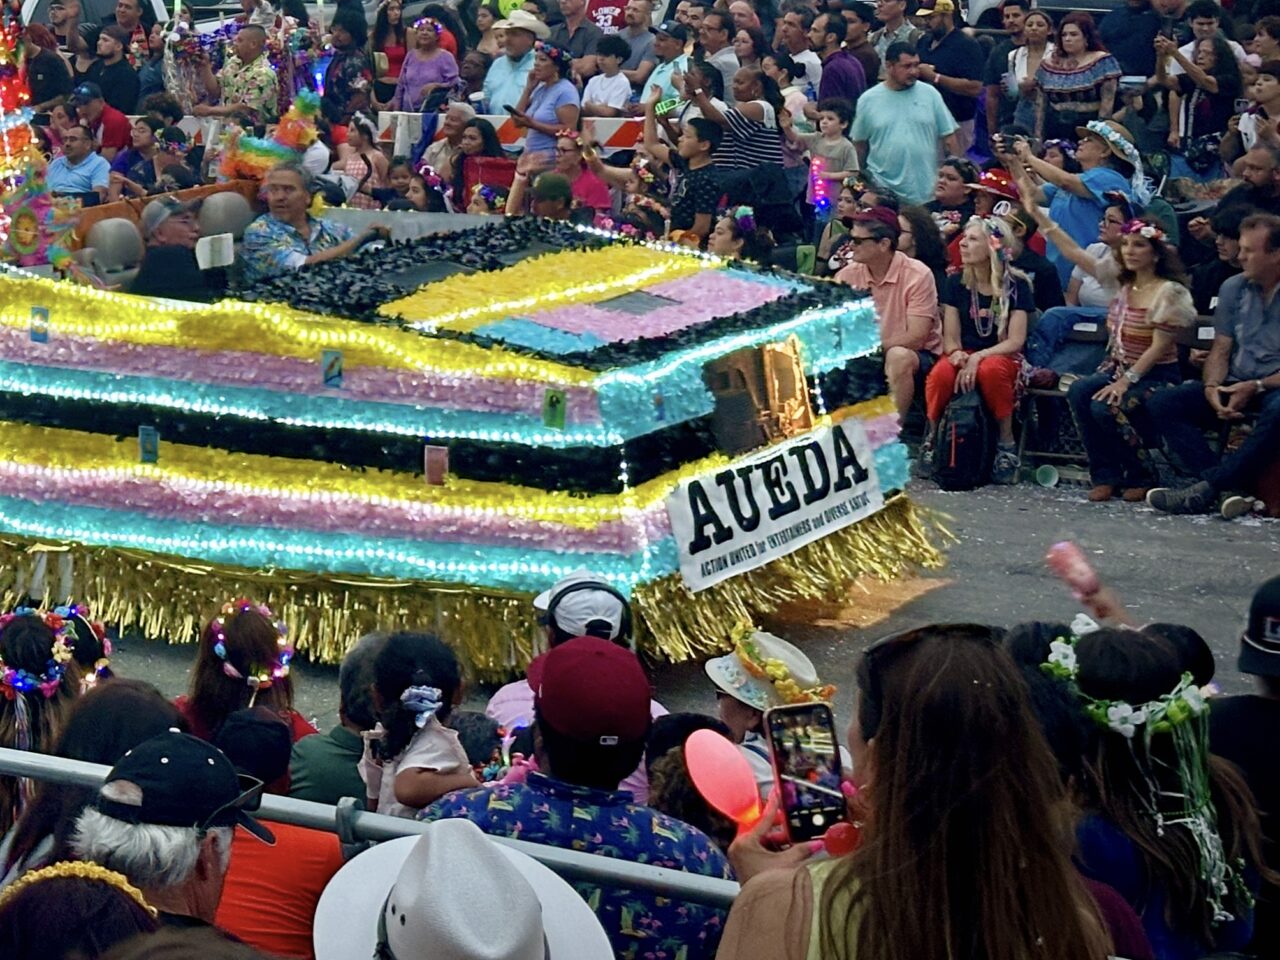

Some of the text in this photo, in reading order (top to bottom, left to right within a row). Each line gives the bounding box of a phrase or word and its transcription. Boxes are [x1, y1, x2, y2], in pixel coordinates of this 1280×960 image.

[596, 14, 612, 27] 33
[687, 424, 869, 557] AUEDA
[700, 554, 729, 578] ACTION
[729, 542, 758, 566] UNITED
[824, 501, 851, 525] DIVERSE
